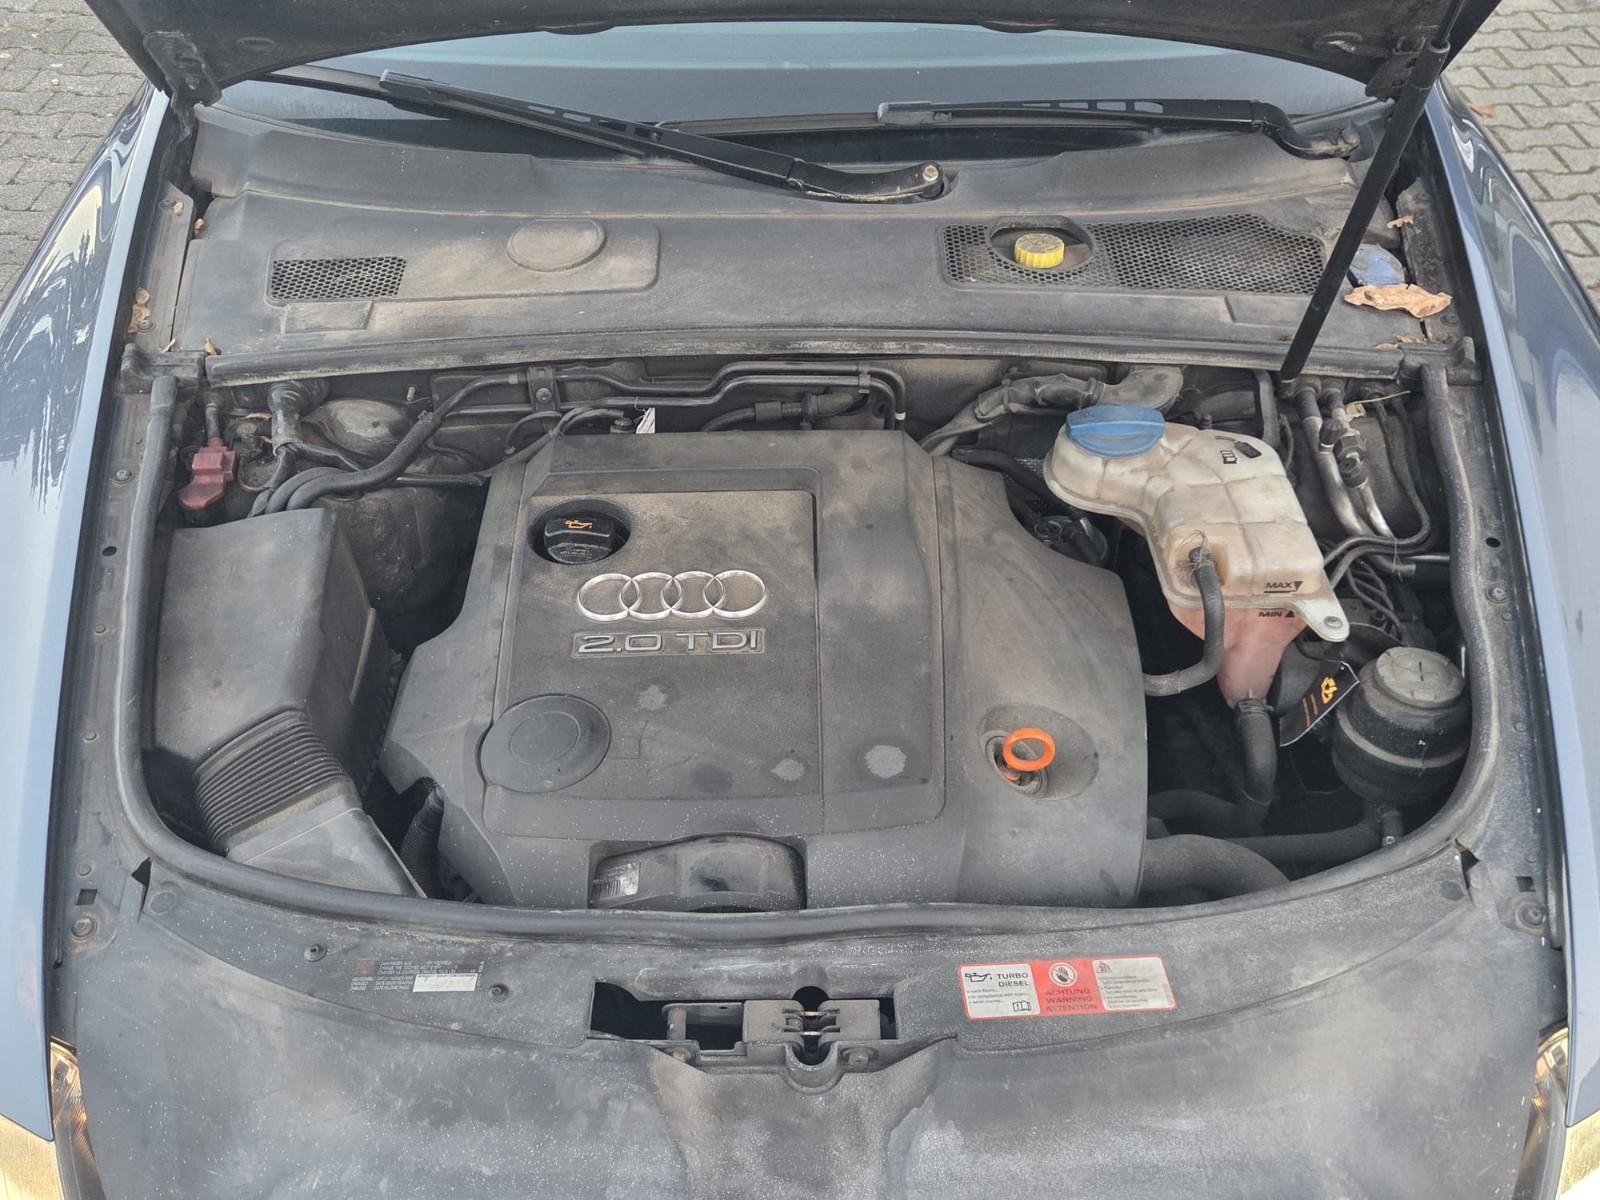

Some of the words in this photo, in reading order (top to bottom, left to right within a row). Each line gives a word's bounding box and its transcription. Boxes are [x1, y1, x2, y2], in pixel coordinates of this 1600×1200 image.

[1265, 581, 1292, 590] MAX
[1258, 610, 1282, 618] MIN
[578, 633, 663, 653] 2.0
[676, 630, 759, 651] TDI
[997, 972, 1029, 980] TURBO
[998, 980, 1030, 988] DIESEL
[1045, 988, 1090, 996] ACHTUNG
[1046, 996, 1093, 1004] WARNING
[1046, 1003, 1098, 1012] ATTENTION
